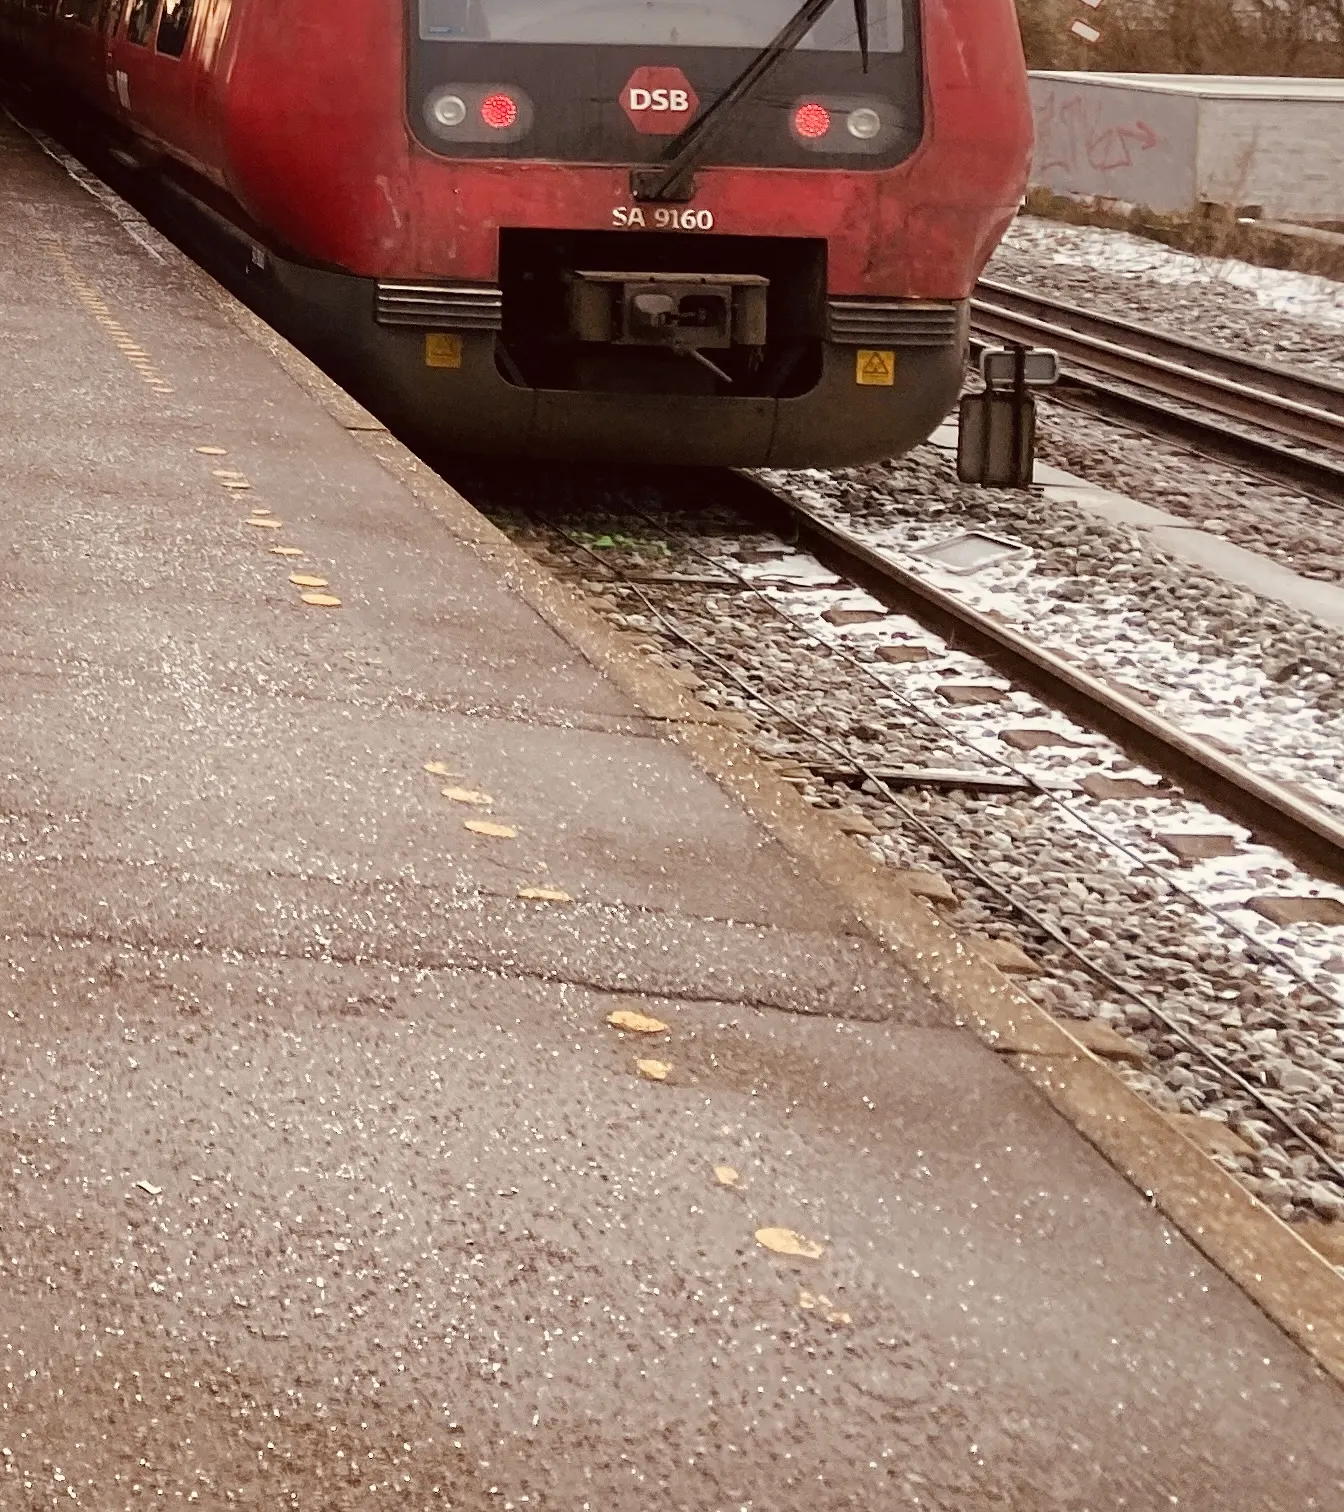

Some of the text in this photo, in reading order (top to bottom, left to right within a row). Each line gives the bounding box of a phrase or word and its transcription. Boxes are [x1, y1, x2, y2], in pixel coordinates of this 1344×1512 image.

[629, 88, 690, 112] DSB
[612, 206, 714, 231] SA 9160
